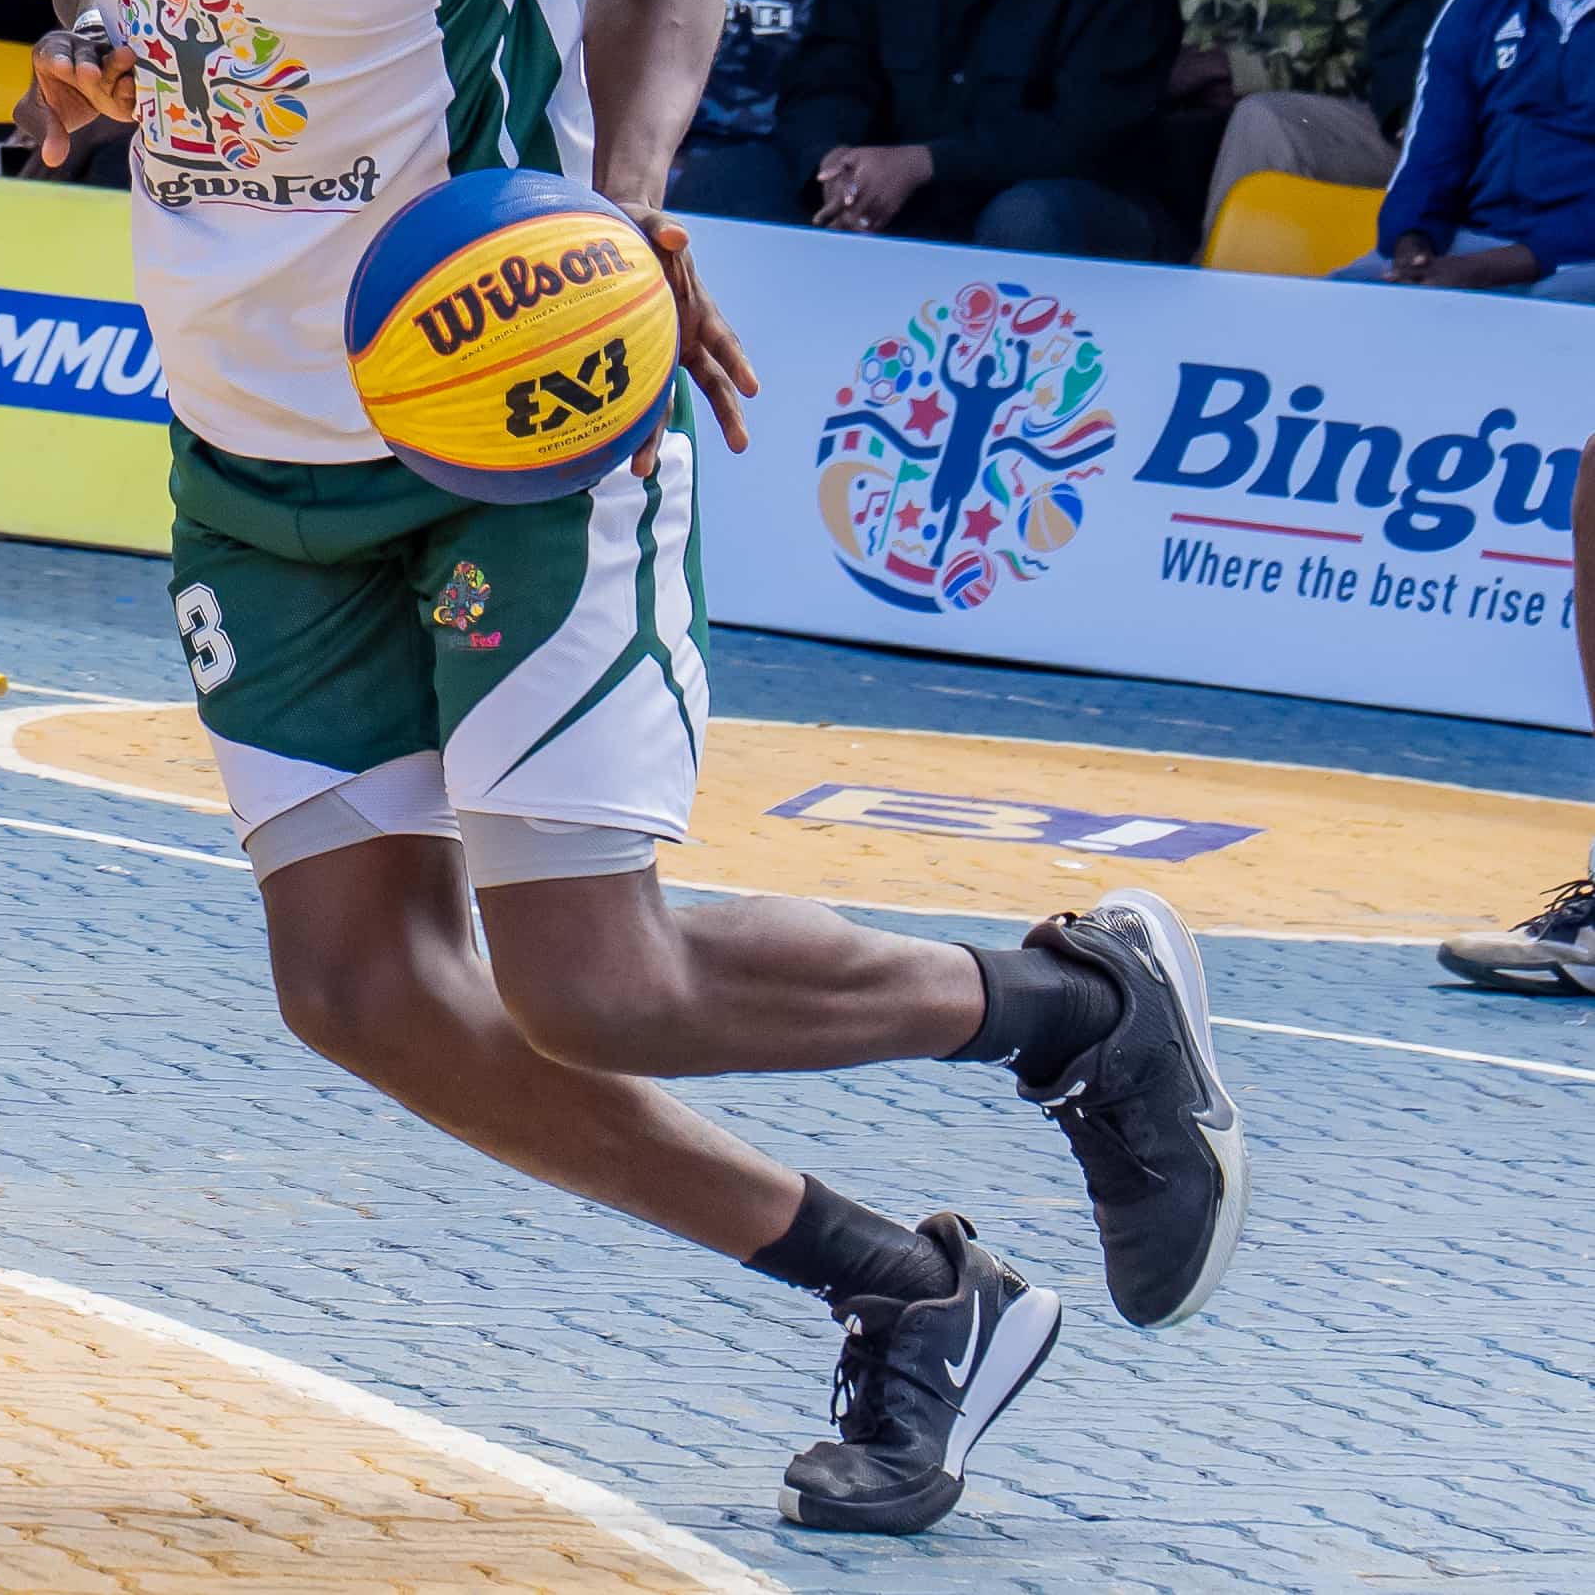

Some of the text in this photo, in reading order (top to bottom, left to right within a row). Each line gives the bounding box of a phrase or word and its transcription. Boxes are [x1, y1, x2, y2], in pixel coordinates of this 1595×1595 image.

[413, 238, 632, 356] Wilson
[538, 432, 590, 453] OFFICIAL
[593, 416, 620, 433] BALL
[1161, 536, 1283, 594] Where
[1297, 555, 1359, 603] the
[1370, 561, 1458, 615] best
[1468, 577, 1546, 627] rise
[176, 582, 236, 695] 3
